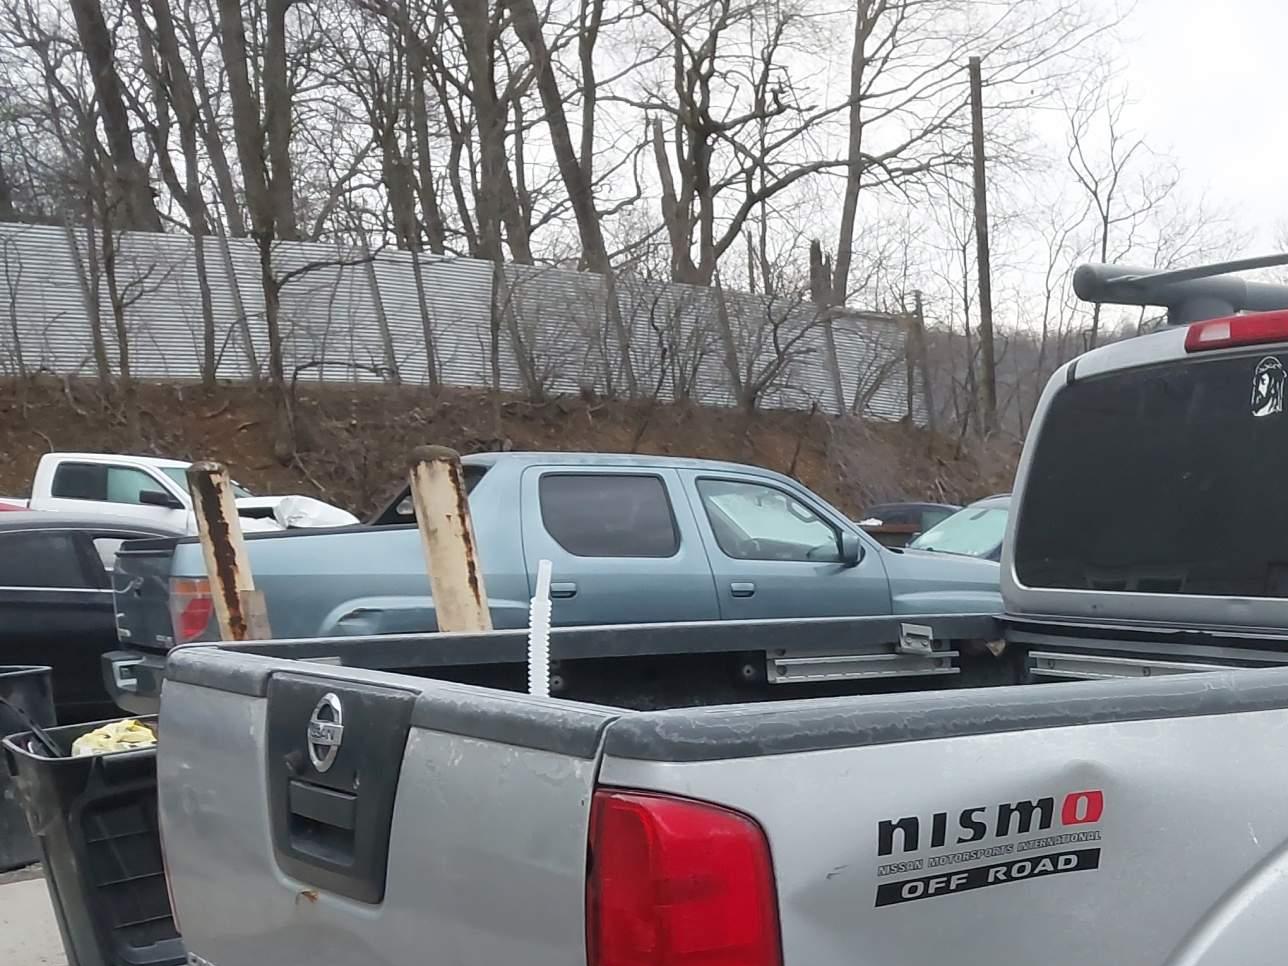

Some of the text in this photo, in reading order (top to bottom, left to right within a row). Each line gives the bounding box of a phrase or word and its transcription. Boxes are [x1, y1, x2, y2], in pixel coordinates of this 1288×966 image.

[877, 829, 1102, 878] NISSAN MOTORSPORTS INTERNATIONAL
[901, 853, 1080, 899] OFF ROAD
